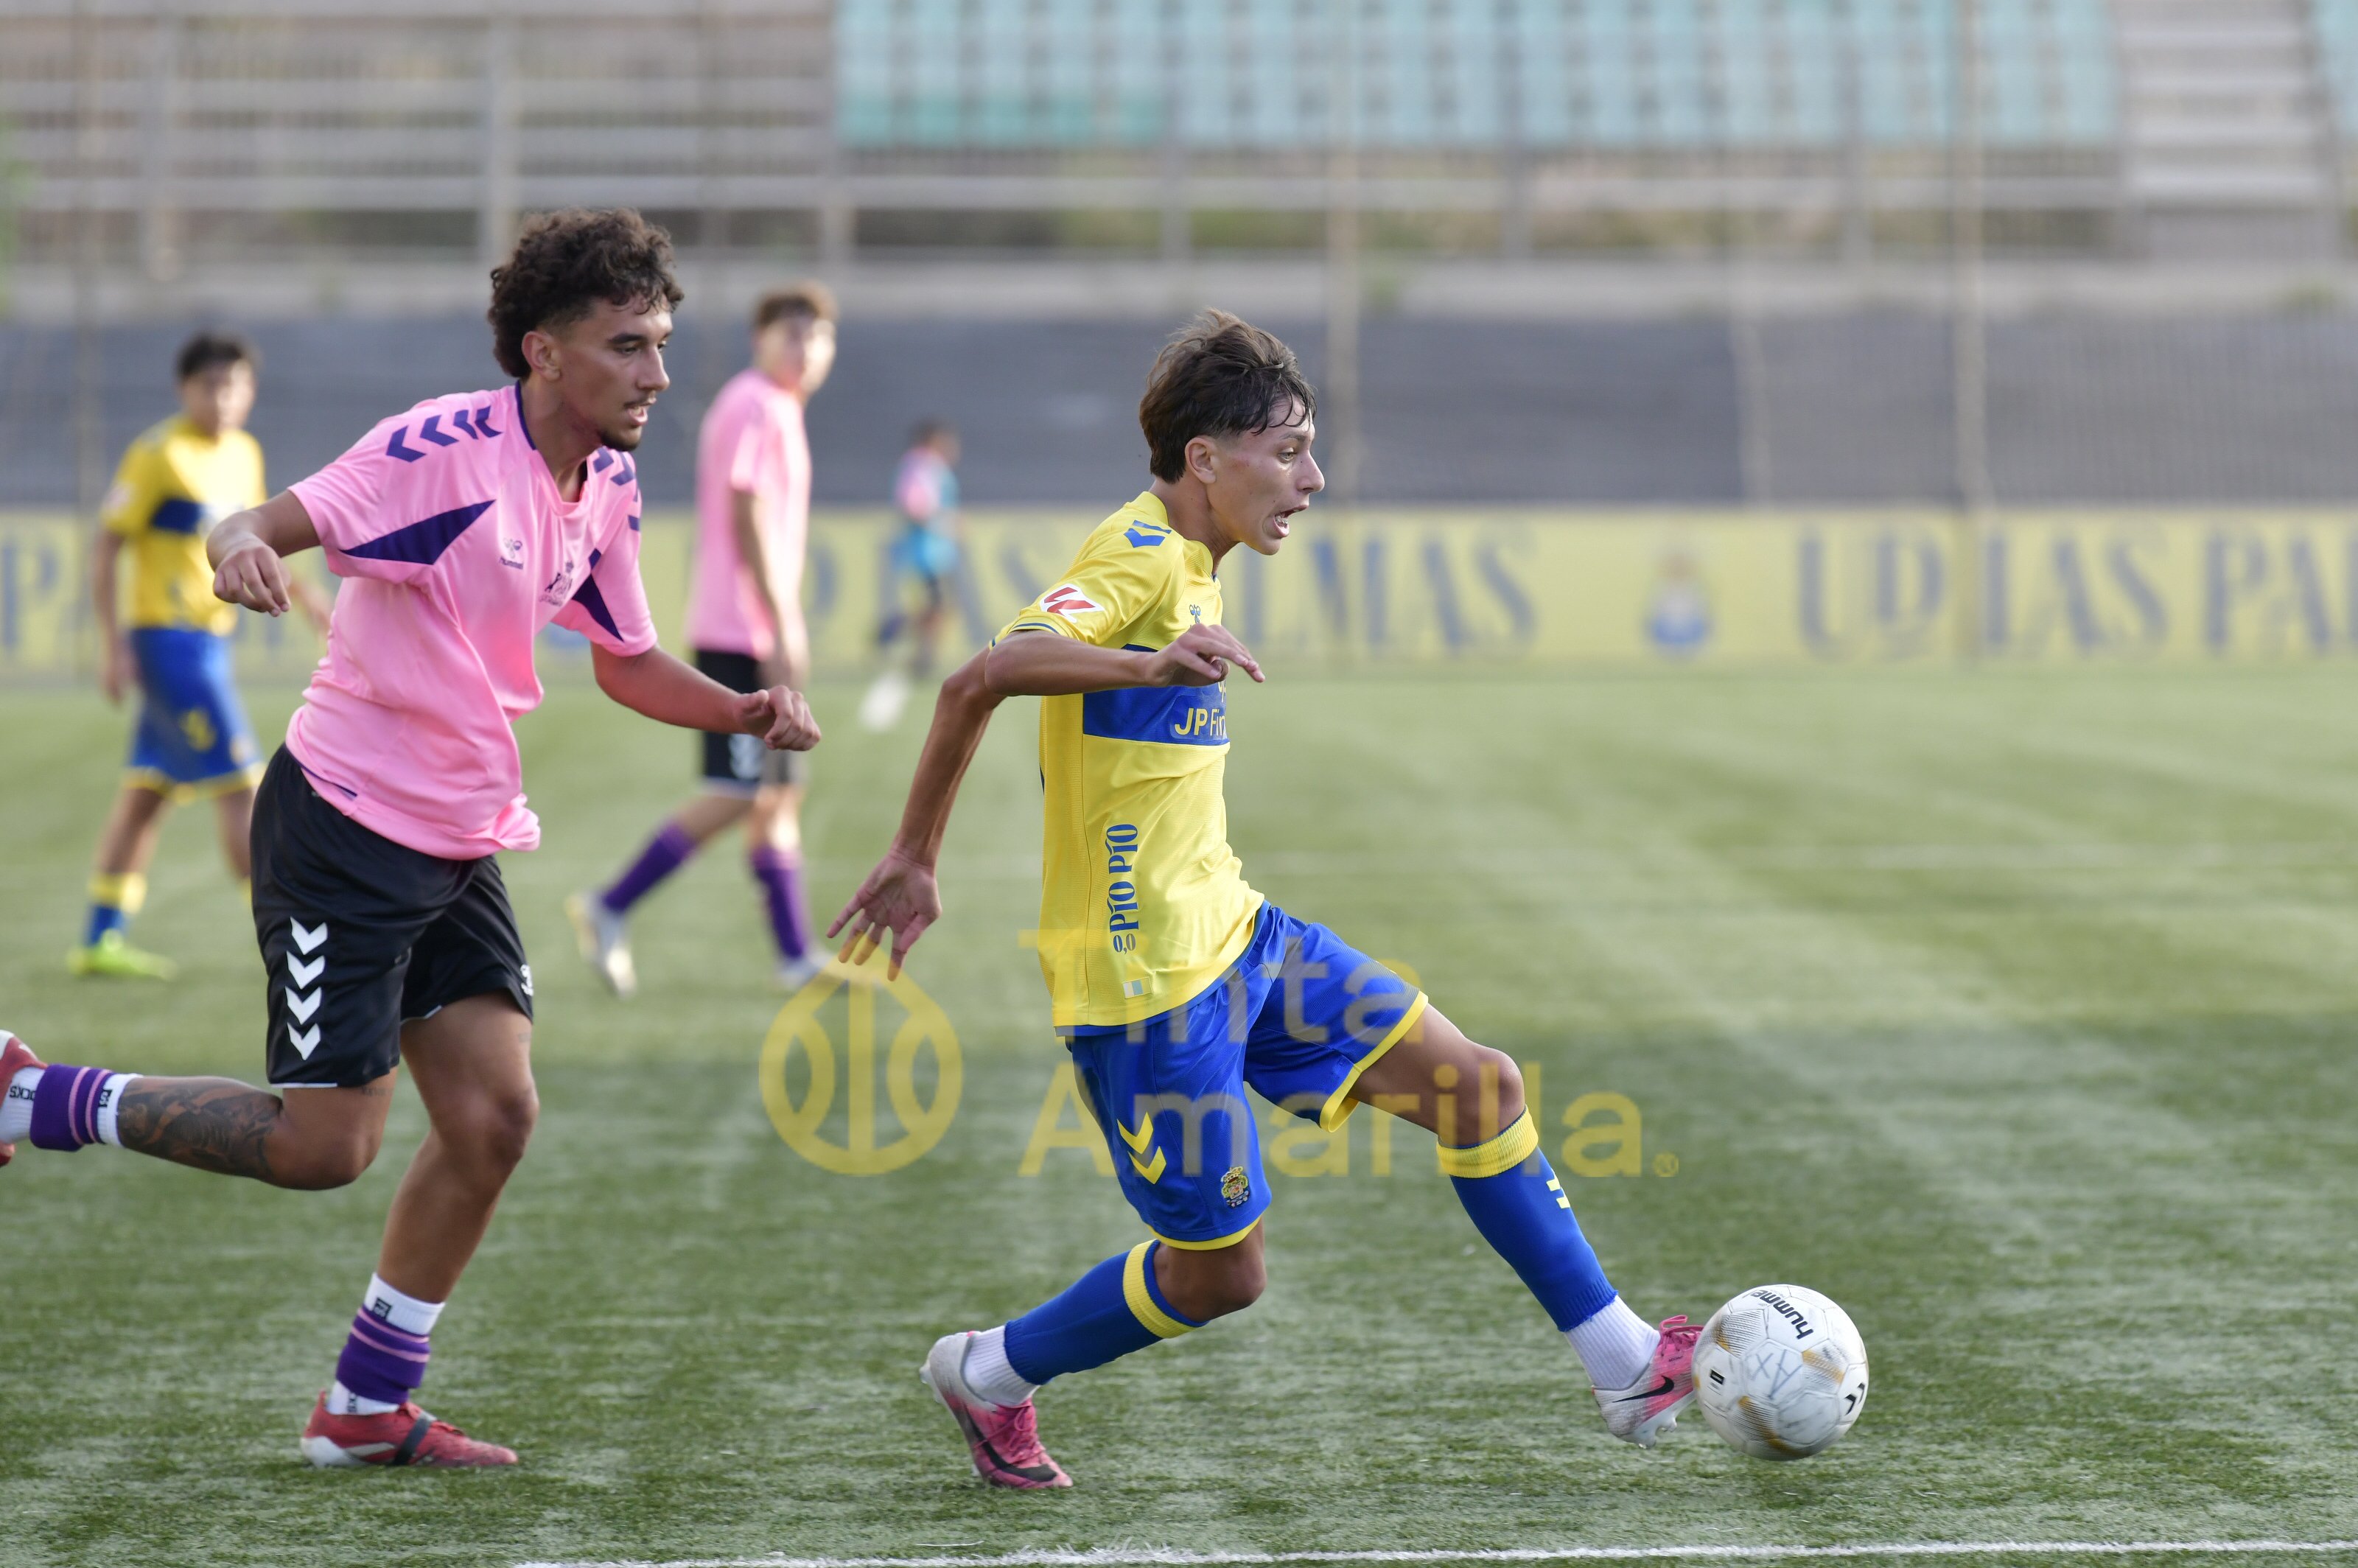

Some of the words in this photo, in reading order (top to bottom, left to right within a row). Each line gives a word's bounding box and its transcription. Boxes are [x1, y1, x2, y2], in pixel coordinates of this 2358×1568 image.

[1795, 536, 1948, 662] UD
[1981, 536, 2171, 653] LAS
[2202, 535, 2358, 653] PA
[1174, 707, 1208, 736] JP
[1741, 1289, 1814, 1340] hummel
